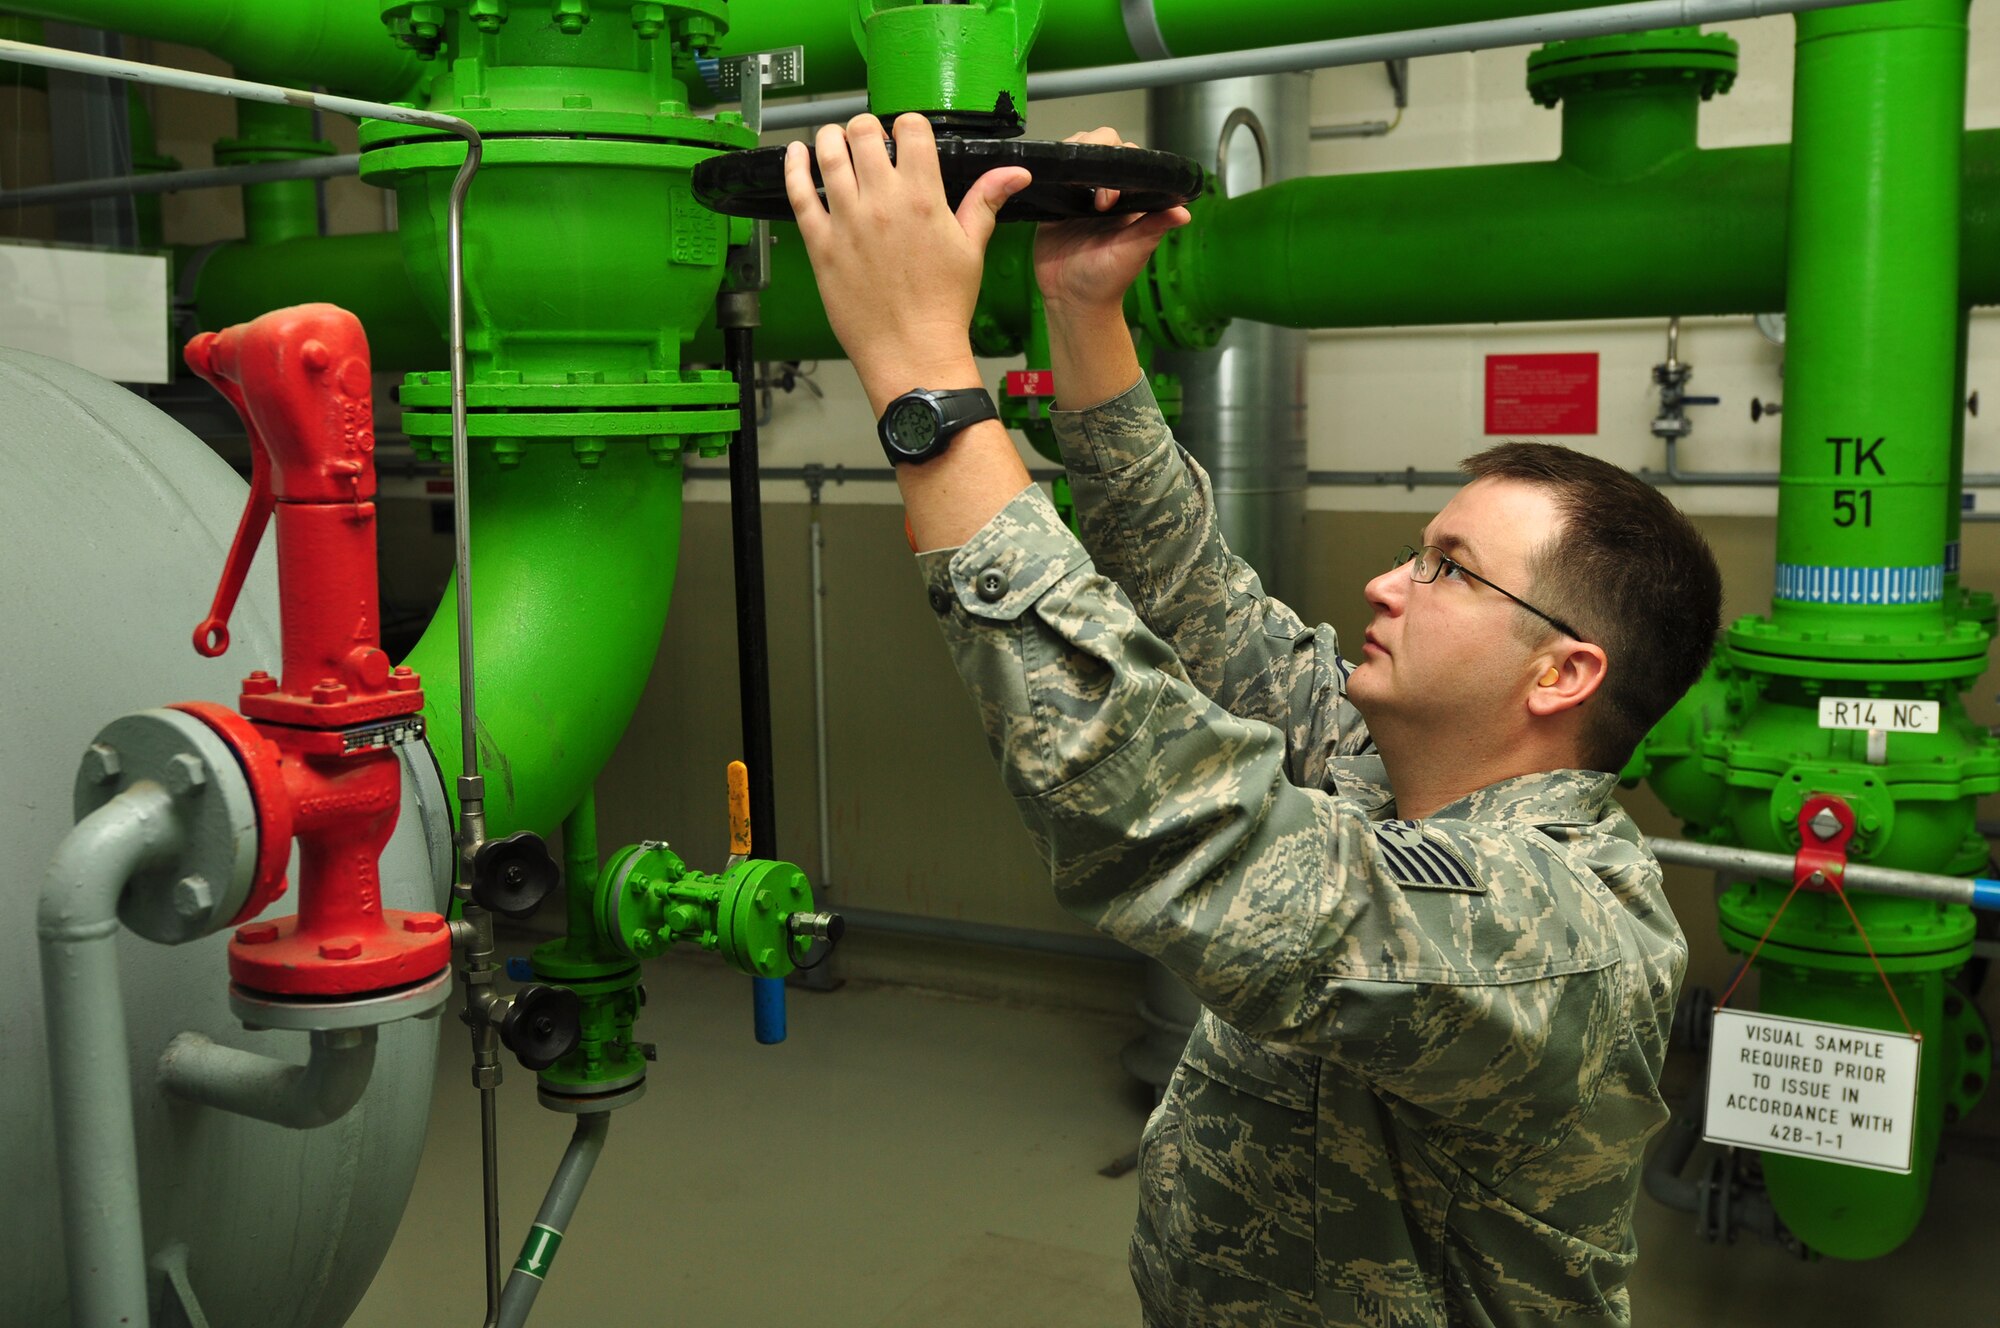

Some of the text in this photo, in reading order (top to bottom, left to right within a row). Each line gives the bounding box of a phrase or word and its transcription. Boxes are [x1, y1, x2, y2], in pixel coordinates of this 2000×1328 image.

[1024, 384, 1037, 394] NC
[1825, 437, 1886, 476] TK
[1833, 489, 1872, 528] 51
[1835, 702, 1922, 728] R14 NC
[1746, 1025, 1885, 1059] VISUAL SAMPLE
[1740, 1047, 1886, 1084] REQUIRED PRIOR
[1752, 1073, 1859, 1104] TO ISSUE IN
[1726, 1093, 1893, 1134] ACCORDANCE WITH
[1769, 1124, 1843, 1150] 42B-1-1
